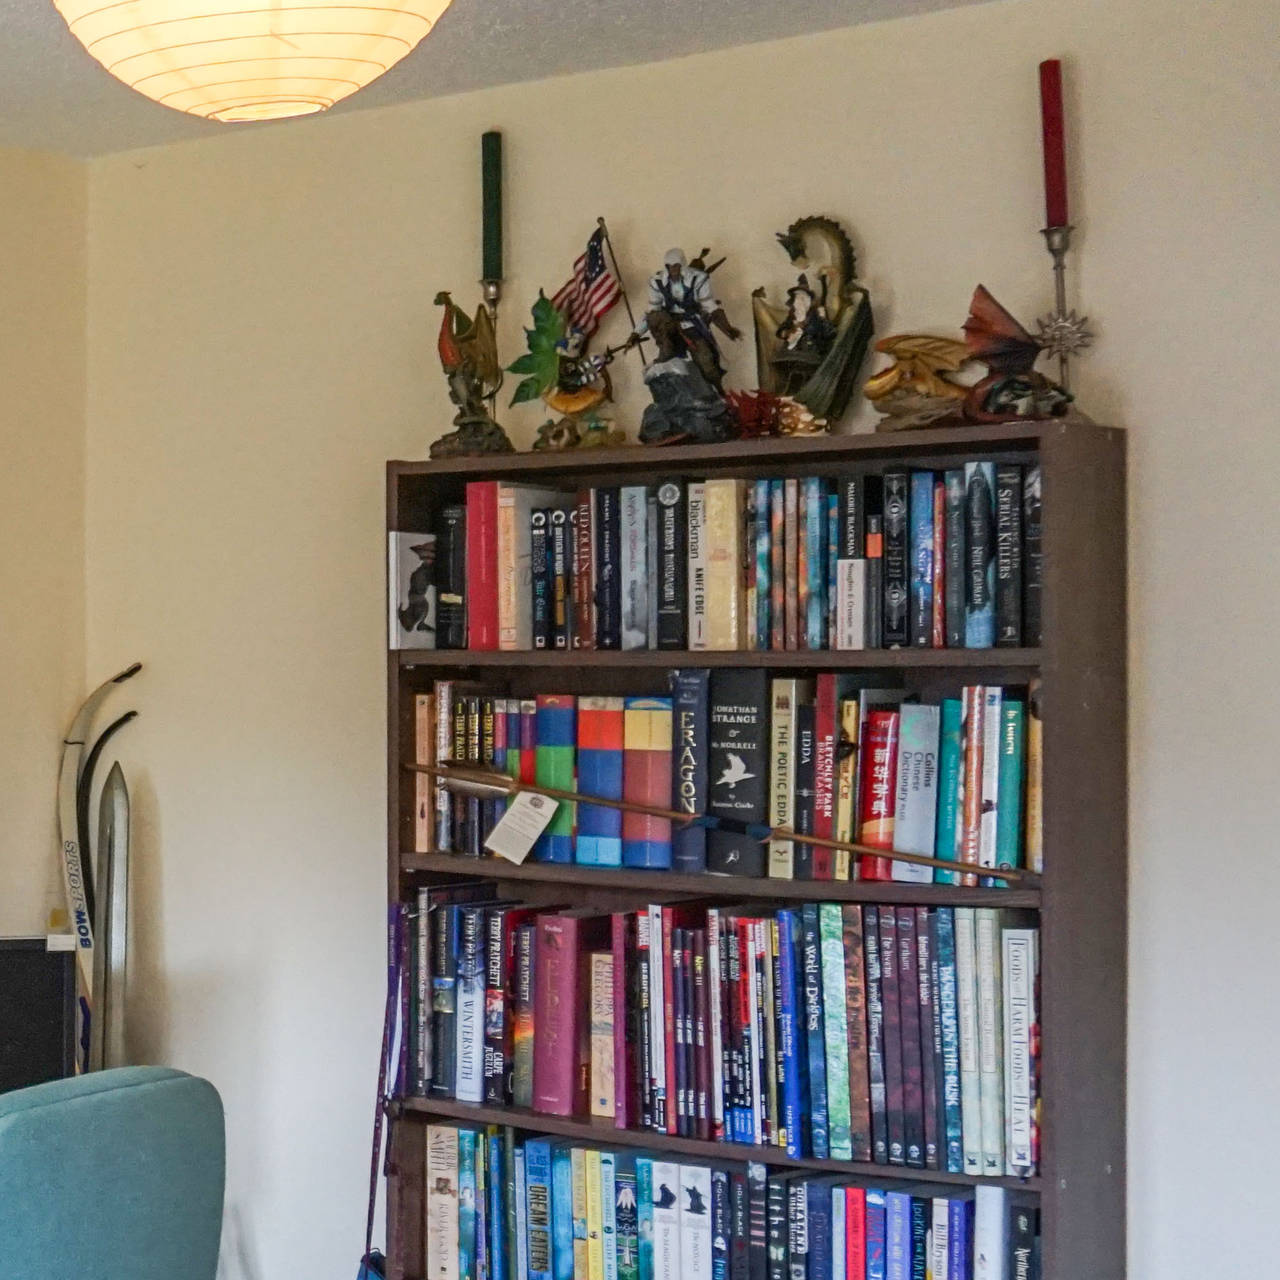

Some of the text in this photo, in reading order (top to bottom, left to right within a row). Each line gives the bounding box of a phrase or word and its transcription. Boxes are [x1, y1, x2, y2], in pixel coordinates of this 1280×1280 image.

[846, 516, 856, 556] BLACKMAN
[998, 489, 1014, 580] SERIAL KILLERS
[689, 500, 705, 616] blackman KNIFE EDGE
[971, 546, 984, 567] NEIL
[712, 715, 757, 724] STRANGE
[681, 711, 697, 814] ERAGON
[801, 730, 812, 765] EDDA
[776, 724, 789, 827] THE POETIC EDDA
[823, 735, 834, 818] BLETCHLEY PARK
[899, 751, 914, 800] Dictionary
[912, 751, 924, 791] Chinese
[924, 752, 936, 787] Collins
[488, 916, 502, 987] TERRY PRATCHETT
[638, 916, 650, 946] MARVEL
[521, 931, 531, 1002] TERRY PRATCHETT
[805, 944, 820, 1031] World Darkness
[1012, 997, 1028, 1037] HARM
[461, 999, 475, 1081] WINTERSMITH
[492, 1051, 504, 1075] CARPE
[529, 1185, 548, 1226] DREAM
[796, 1187, 807, 1254] CORALINE
[530, 1229, 548, 1272] EATERS
[935, 1223, 947, 1243] Bill
[933, 1243, 946, 1277] Bryson
[1015, 1247, 1031, 1280] Northern
